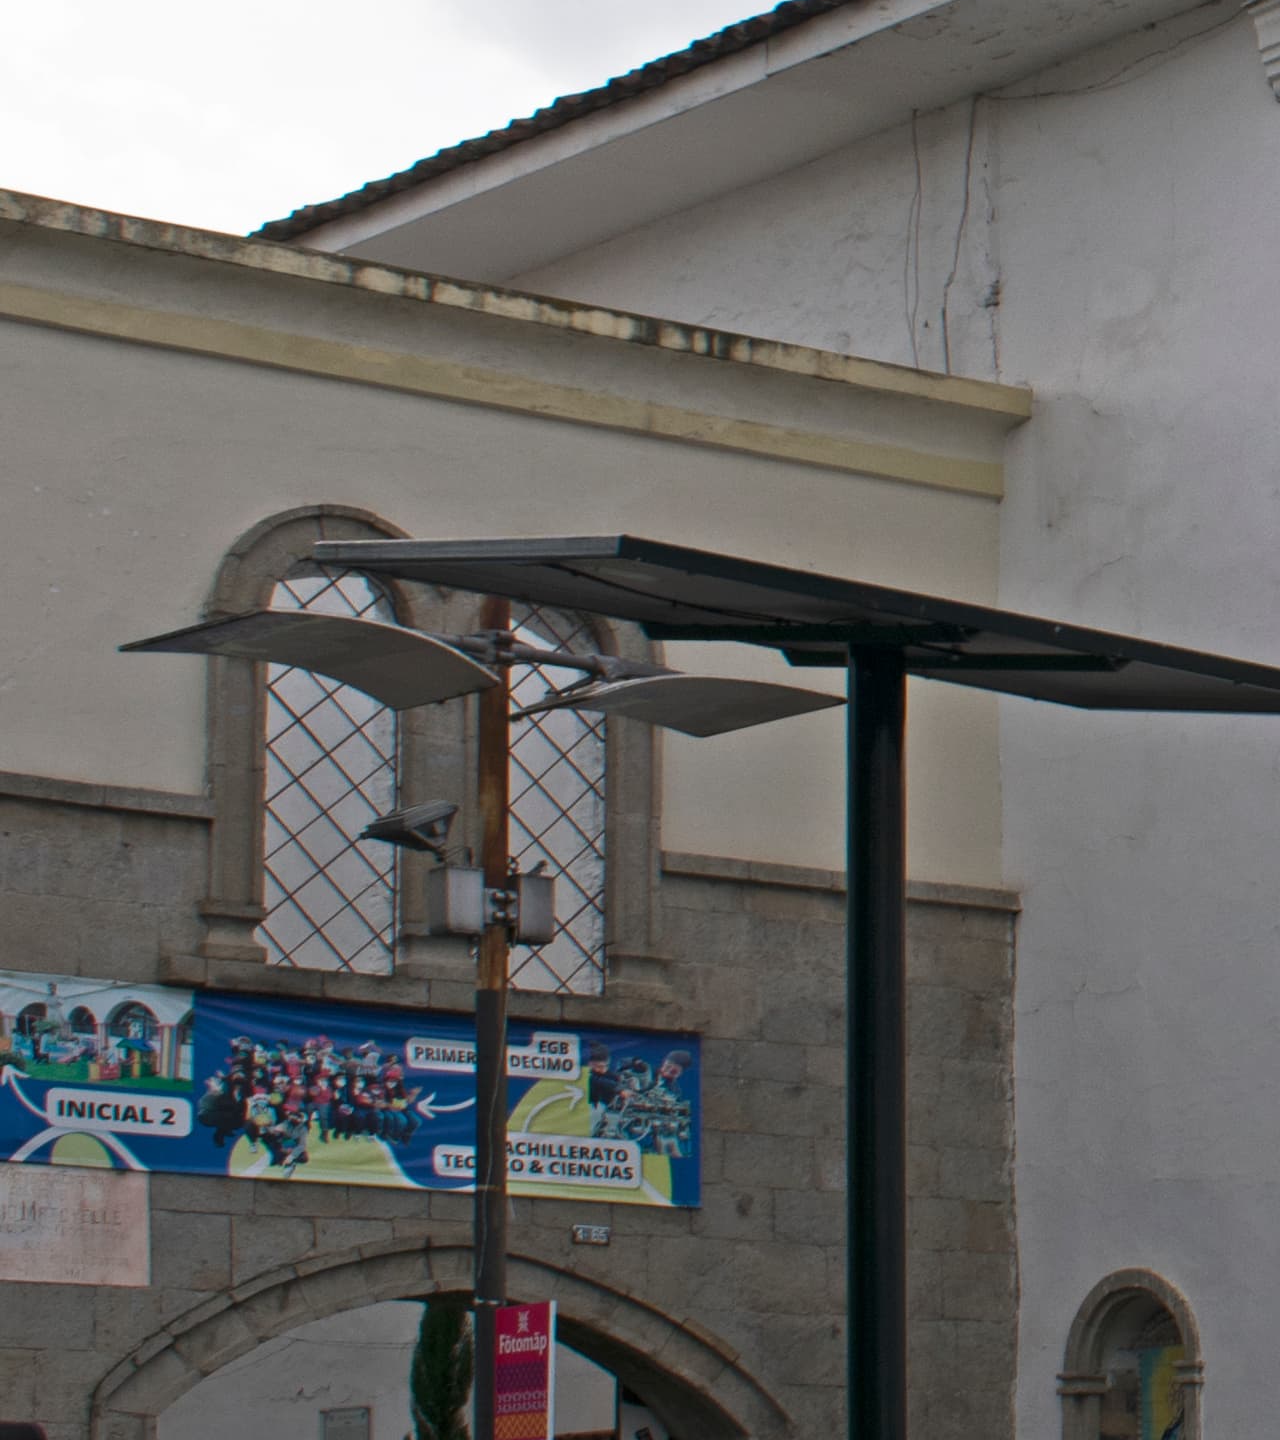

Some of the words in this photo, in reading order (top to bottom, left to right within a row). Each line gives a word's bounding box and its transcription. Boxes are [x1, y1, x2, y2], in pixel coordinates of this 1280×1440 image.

[538, 1040, 569, 1055] EGB
[414, 1046, 477, 1063] PRIMER
[510, 1055, 574, 1072] DECIMO
[57, 1099, 154, 1124] INICIAL
[160, 1108, 176, 1125] 2
[506, 1142, 629, 1163] ACHILLERATO
[549, 1162, 635, 1180] CIENCIAS
